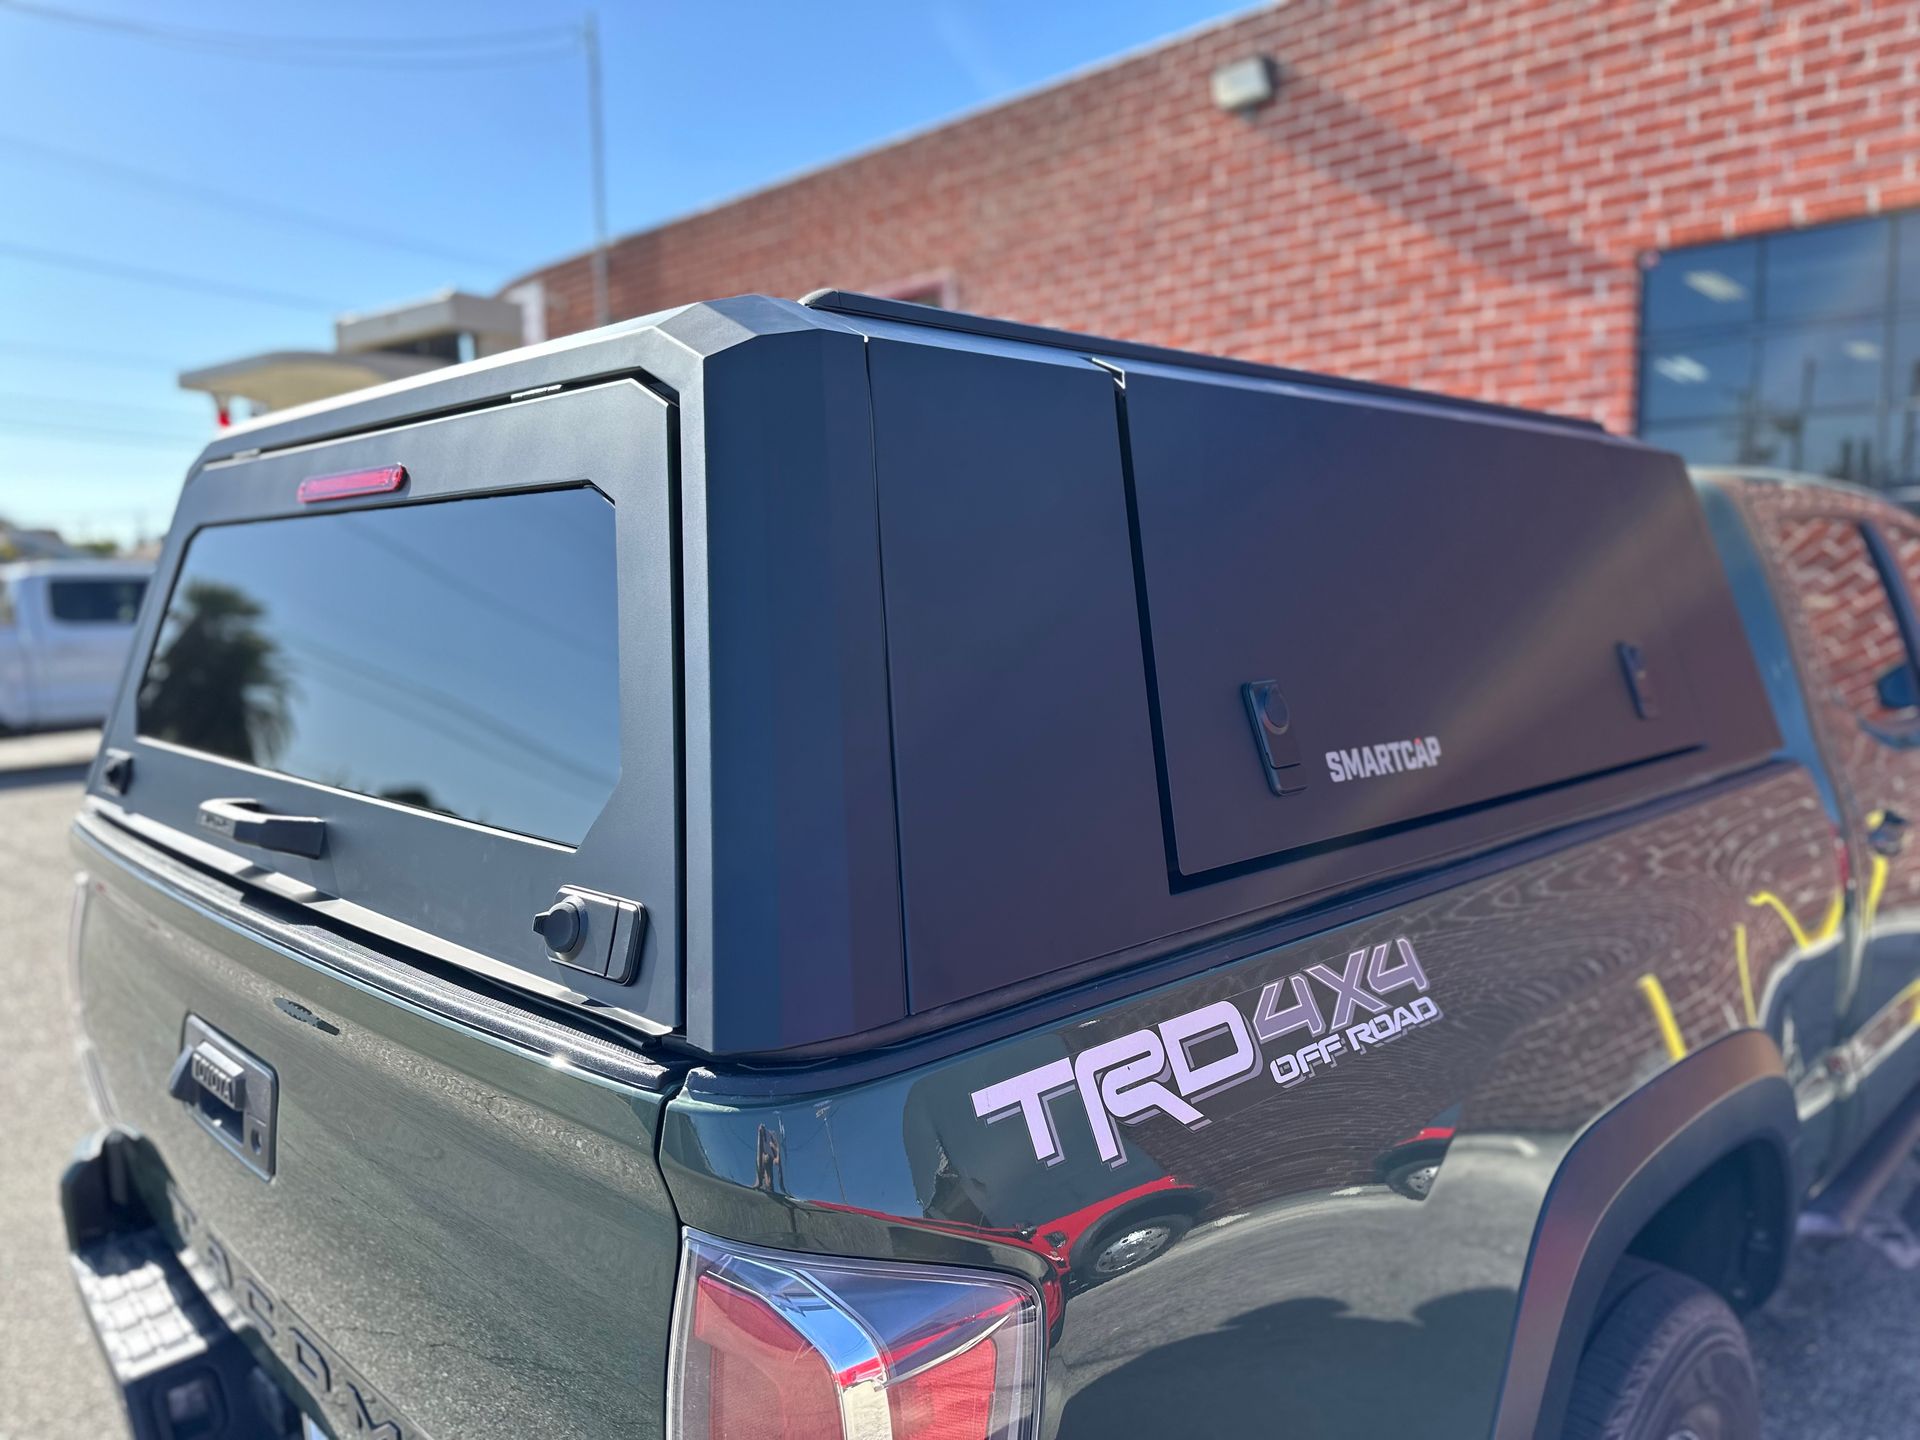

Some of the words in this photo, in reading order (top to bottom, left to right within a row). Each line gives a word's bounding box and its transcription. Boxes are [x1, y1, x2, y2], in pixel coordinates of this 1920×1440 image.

[1325, 736, 1442, 783] SMARTCAP
[969, 999, 1260, 1169] TRD
[1252, 936, 1432, 1044] 4X4
[1269, 1033, 1346, 1088] OFF
[1345, 996, 1443, 1055] ROAD
